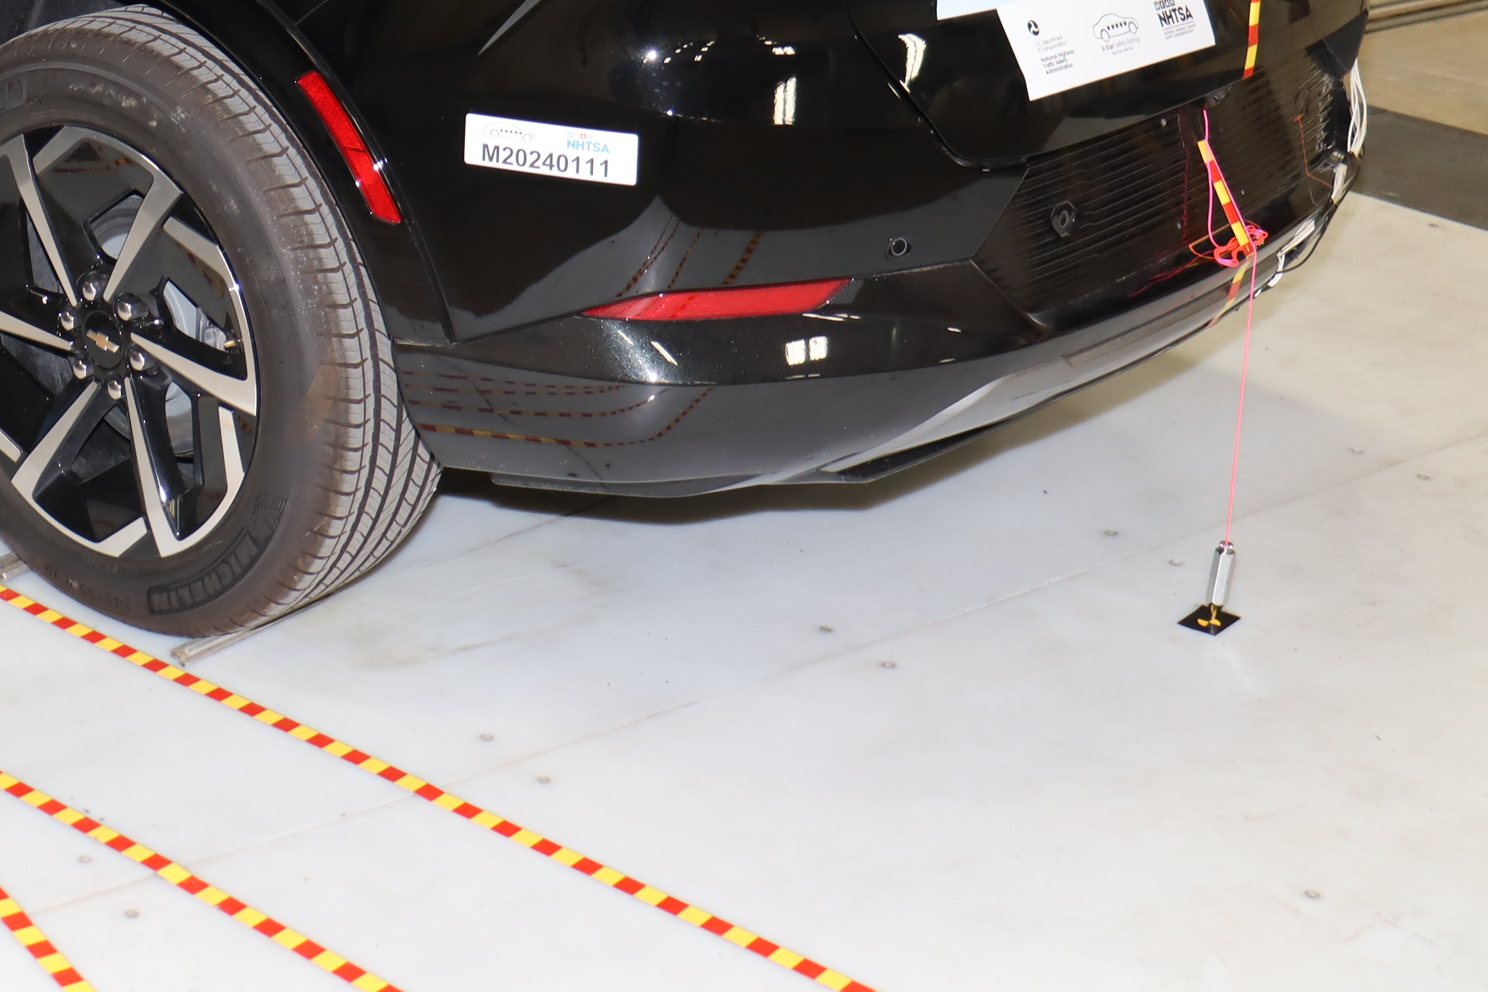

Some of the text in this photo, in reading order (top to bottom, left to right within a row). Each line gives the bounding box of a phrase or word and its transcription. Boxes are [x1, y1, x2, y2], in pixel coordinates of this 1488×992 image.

[1157, 5, 1194, 27] NHTSA
[566, 138, 610, 154] NHTSA
[481, 143, 610, 178] M20240111
[150, 534, 259, 612] MICHELIN
